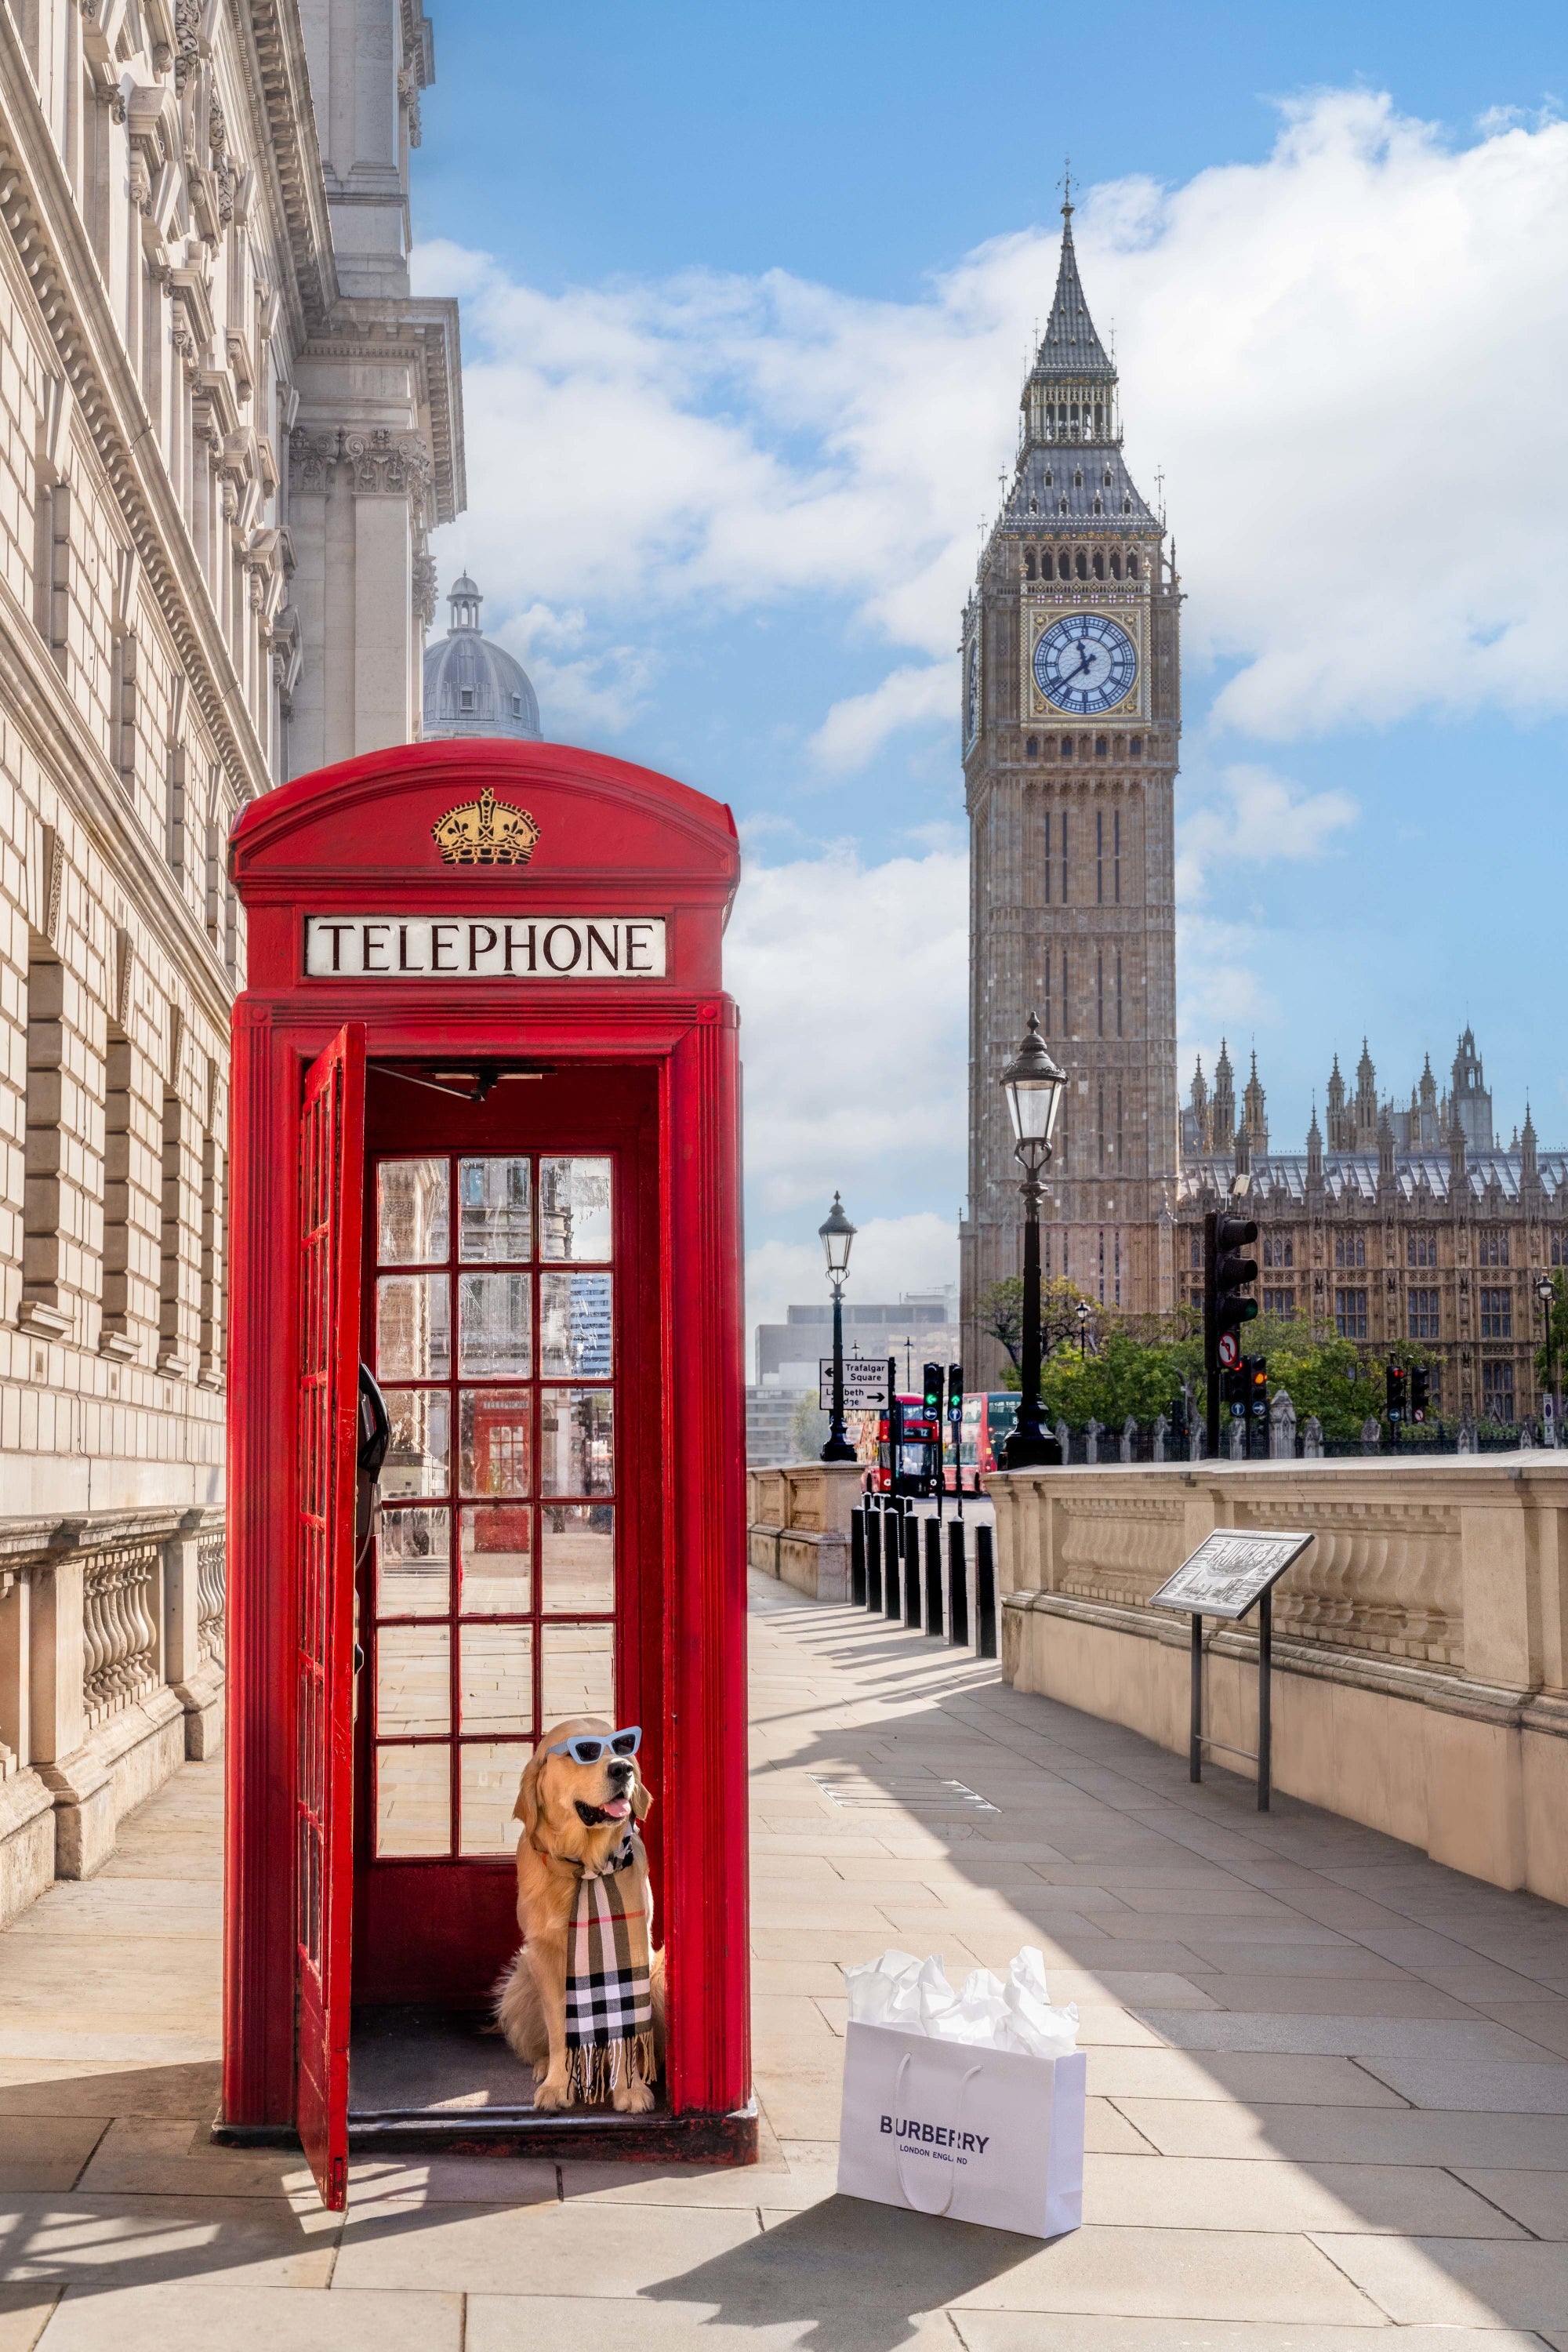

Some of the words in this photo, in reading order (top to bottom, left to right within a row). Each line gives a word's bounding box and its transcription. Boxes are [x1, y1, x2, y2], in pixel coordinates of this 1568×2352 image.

[318, 924, 654, 971] TELEPHONE
[846, 1364, 885, 1373] Trafalgar
[880, 2114, 989, 2154] BURBERRY
[899, 2144, 930, 2157] LONDON
[932, 2151, 967, 2165] ENGLND
